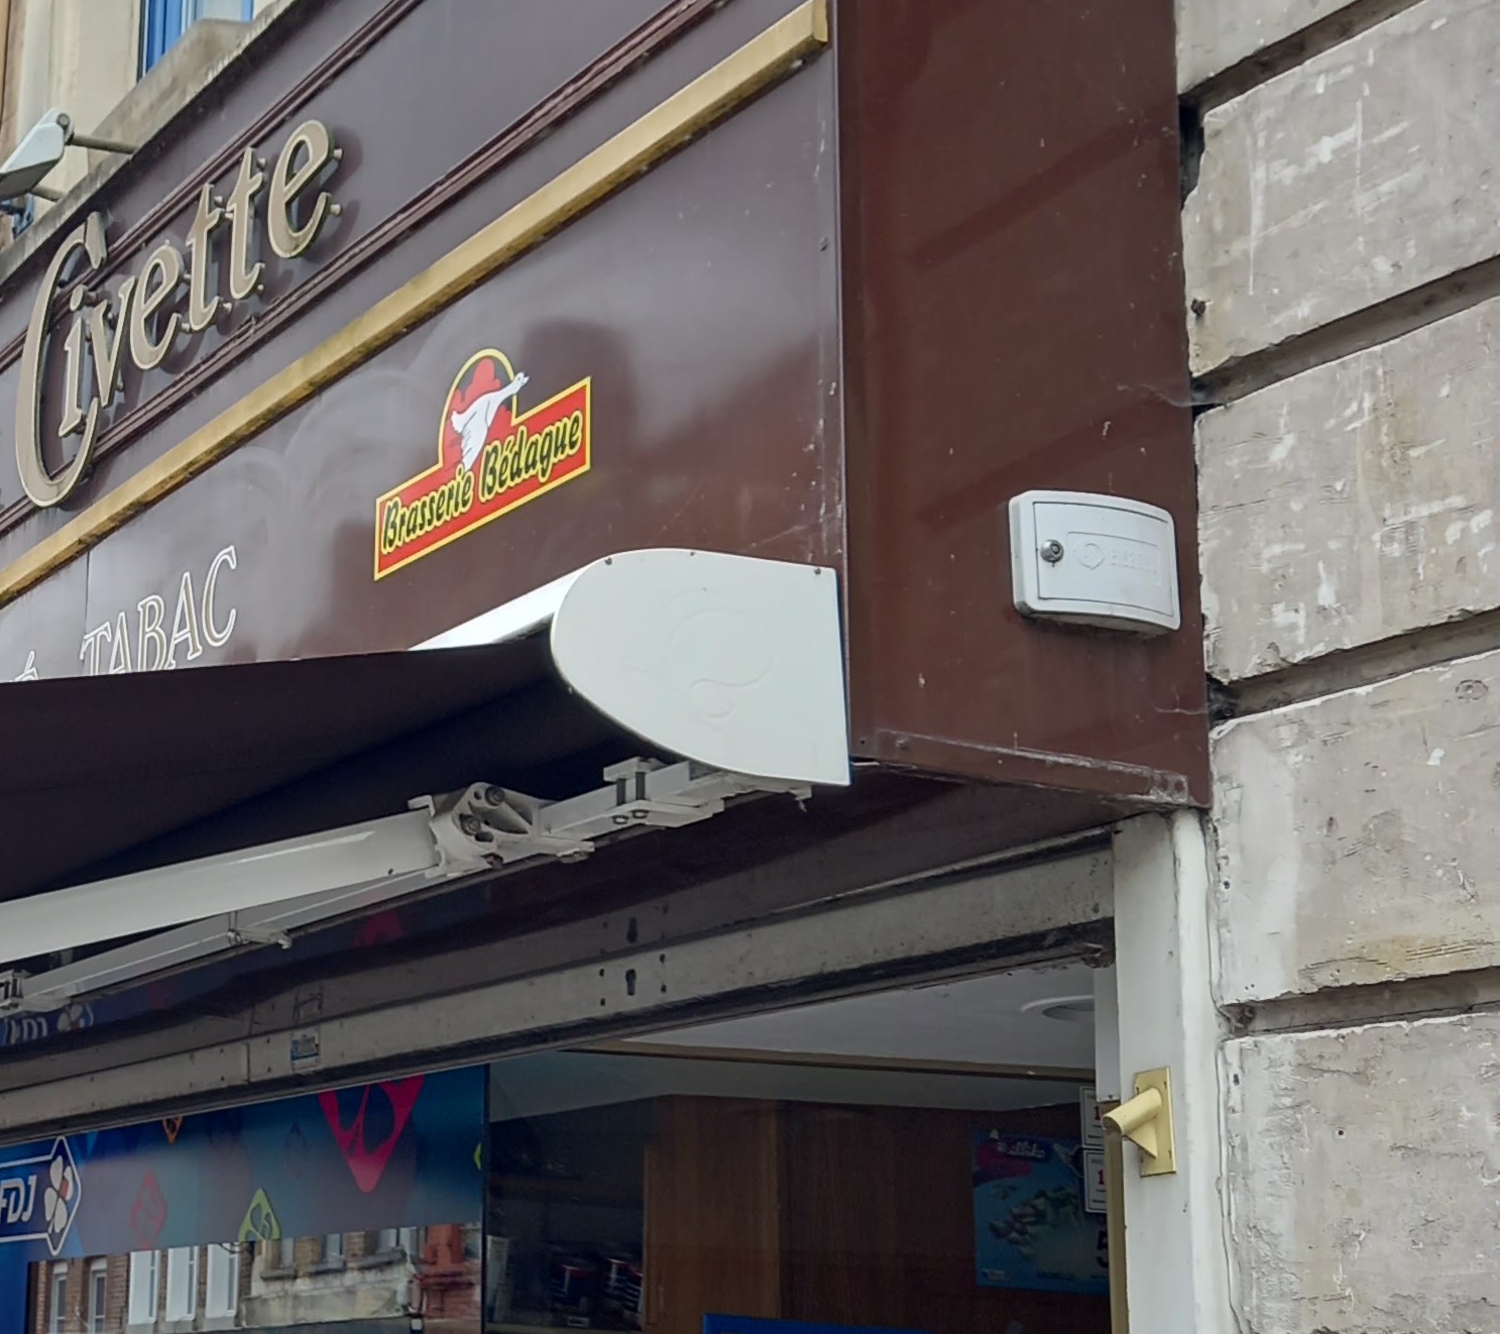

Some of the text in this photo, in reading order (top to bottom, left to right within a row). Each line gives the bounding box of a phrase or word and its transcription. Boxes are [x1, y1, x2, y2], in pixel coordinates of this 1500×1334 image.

[14, 119, 340, 509] Civette
[381, 410, 582, 555] Brasserie Bédague
[79, 545, 237, 676] TABAC
